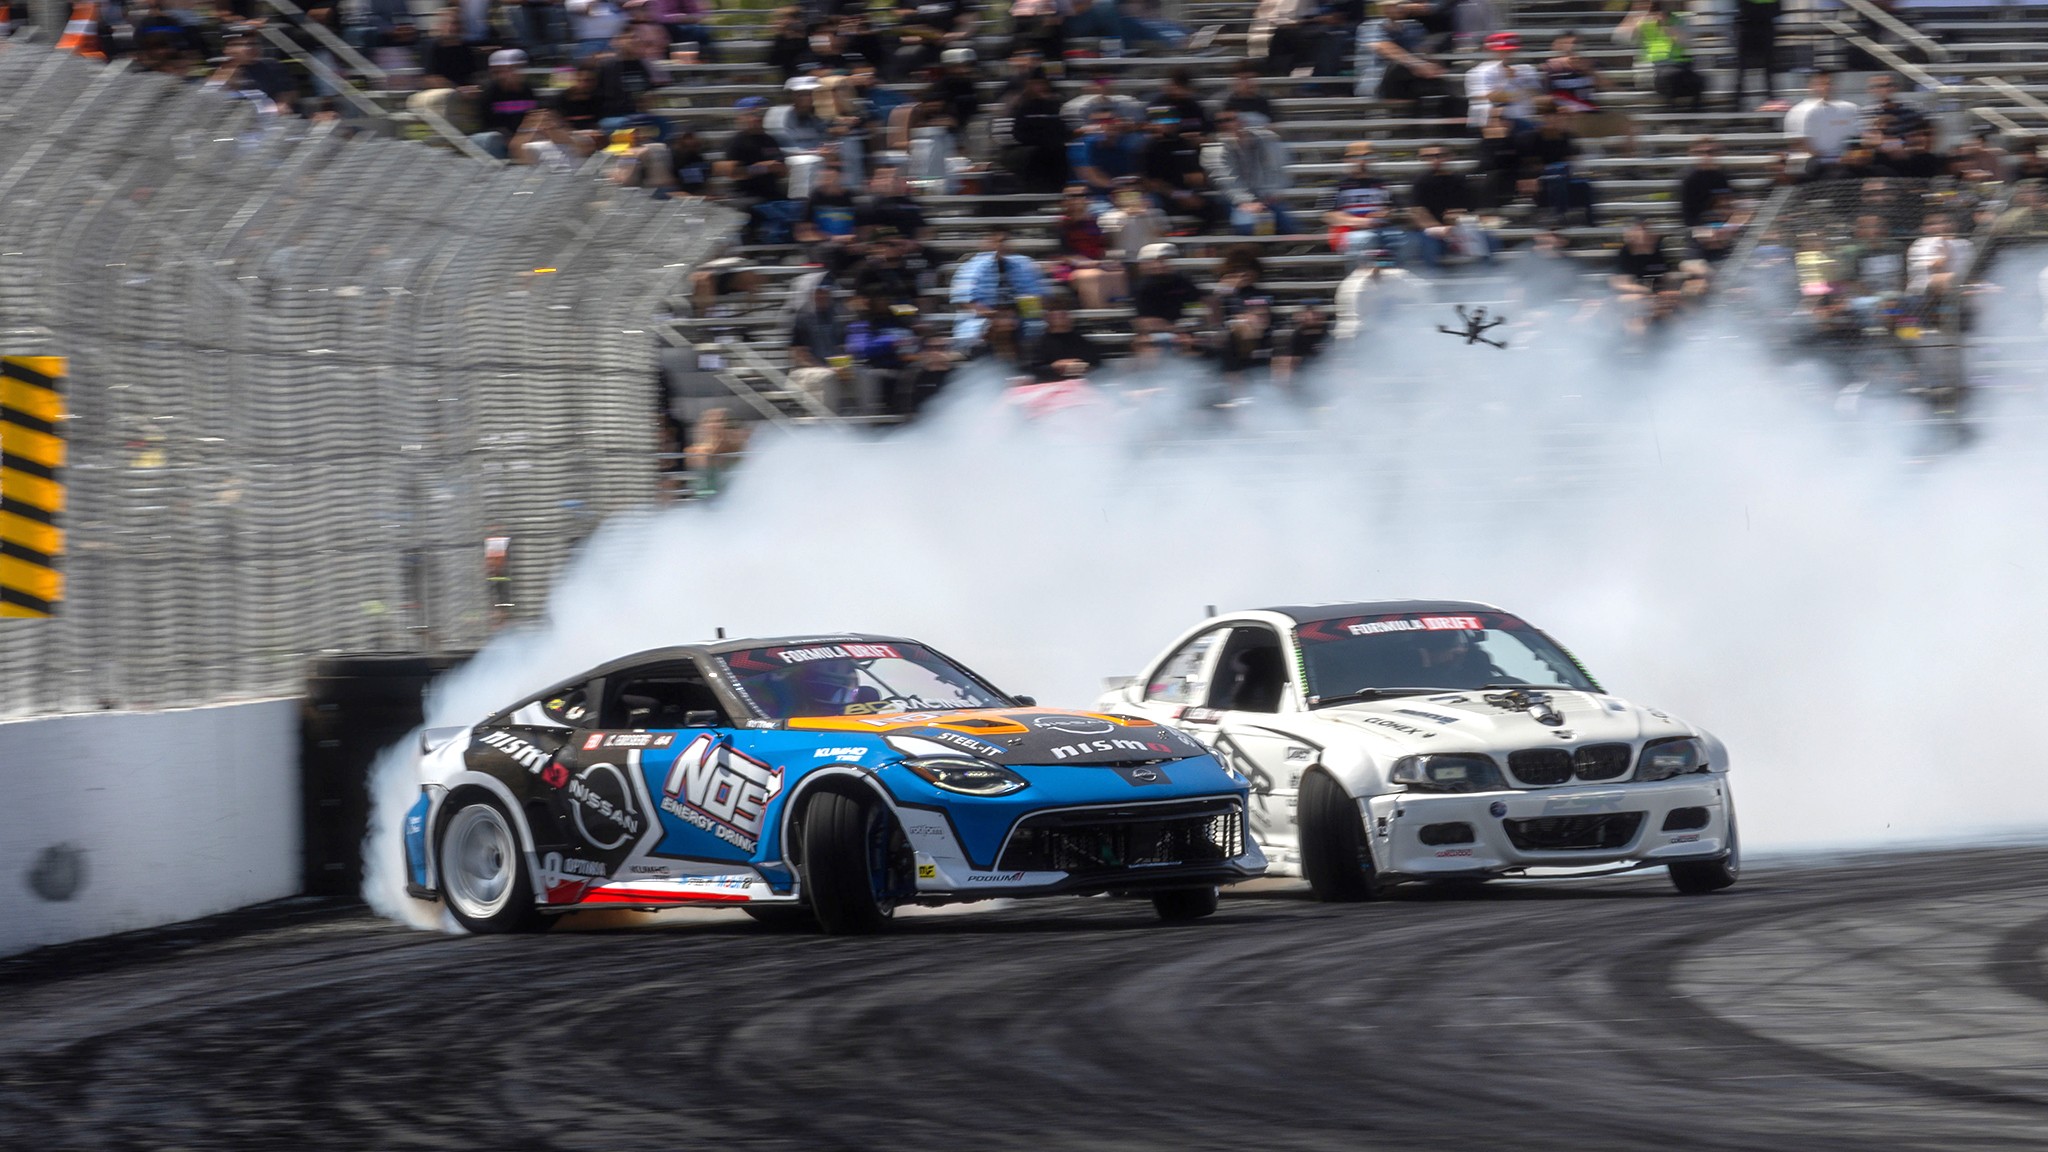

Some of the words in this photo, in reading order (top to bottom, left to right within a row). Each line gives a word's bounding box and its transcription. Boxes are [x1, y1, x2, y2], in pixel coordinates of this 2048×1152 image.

[1348, 619, 1425, 636] FORMULA
[1422, 616, 1478, 630] DRIFT
[777, 646, 851, 663] FORMULA
[846, 645, 898, 659] DRIFT
[813, 747, 868, 758] KUMHO
[937, 732, 1004, 757] STEEL-IT
[664, 734, 783, 840] NOS
[567, 778, 639, 834] NISSAN
[660, 796, 716, 832] ENERGY
[714, 824, 759, 854] DRINK
[967, 874, 1016, 882] PODIUM
